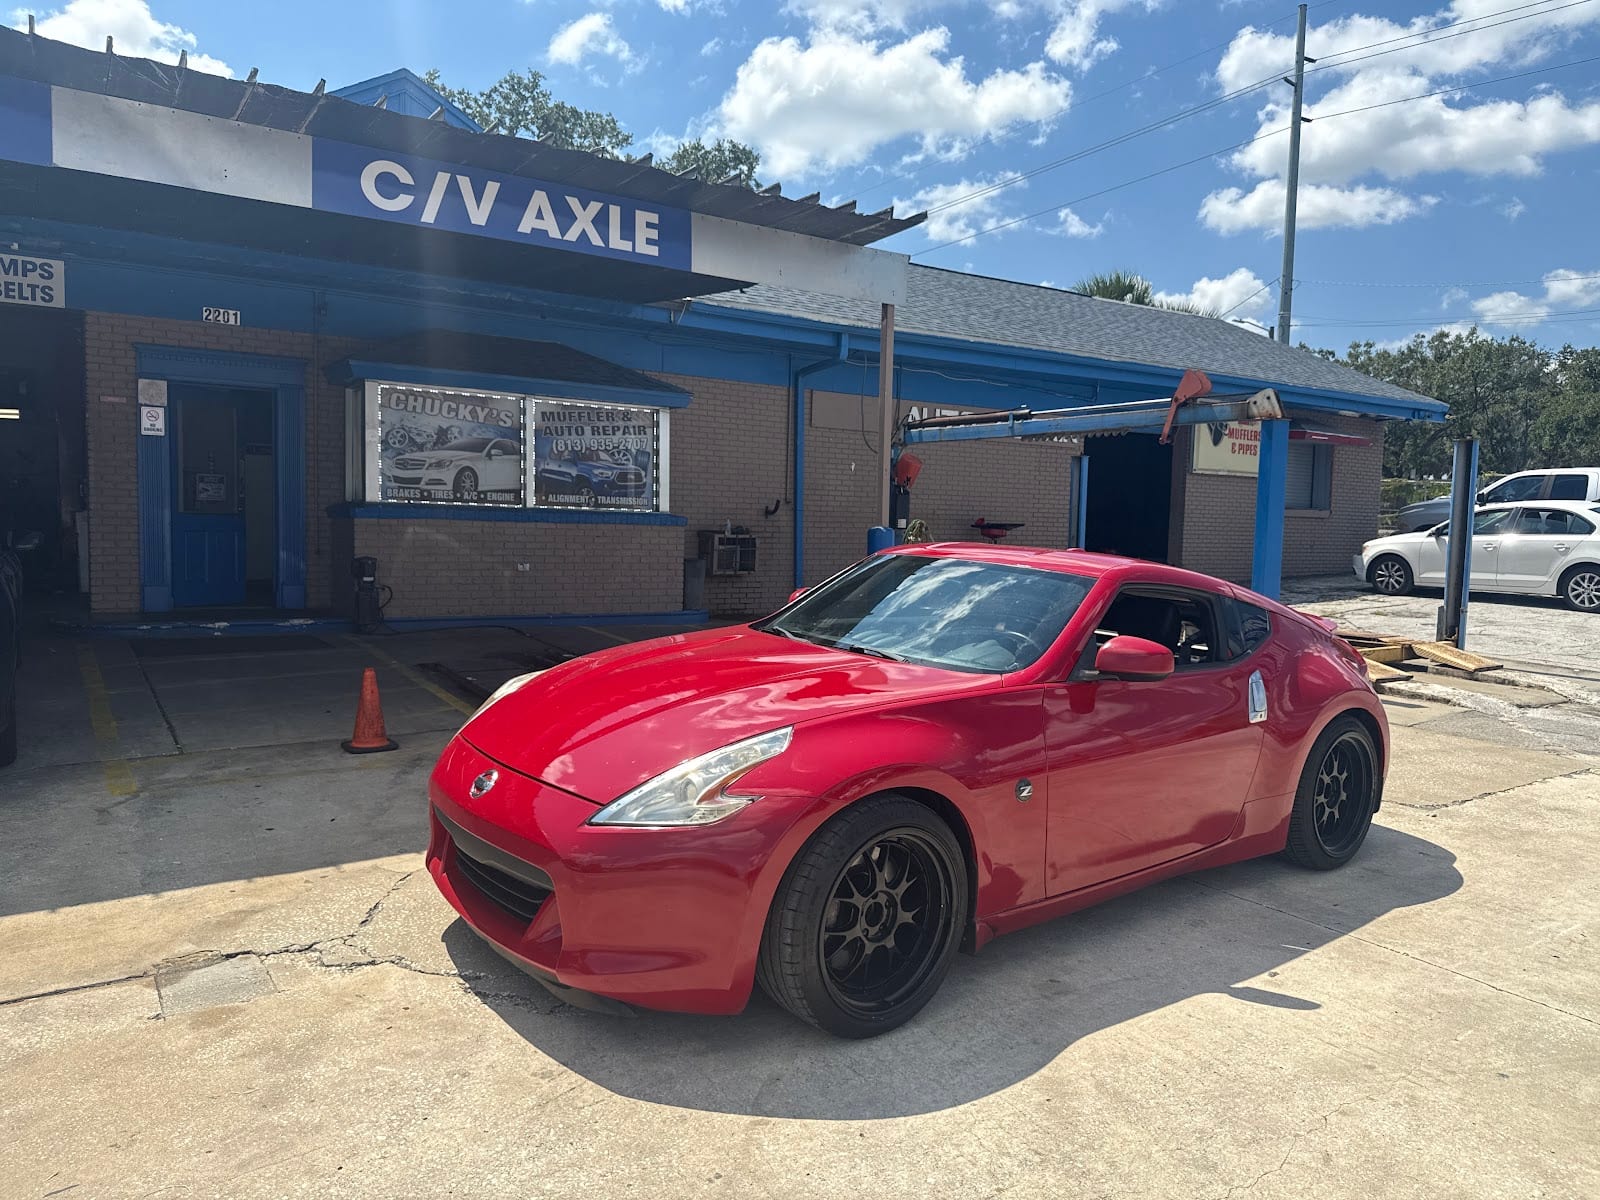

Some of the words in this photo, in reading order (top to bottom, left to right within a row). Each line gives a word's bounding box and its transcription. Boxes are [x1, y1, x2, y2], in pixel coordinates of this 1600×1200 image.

[360, 159, 501, 226] C/V
[517, 189, 659, 257] AXLE
[0, 281, 54, 304] ELTS
[204, 308, 238, 325] 2201
[389, 392, 514, 427] CHUCKY'S
[540, 411, 615, 422] MUFFLER
[621, 411, 633, 422] &
[543, 425, 585, 437] AUTO
[590, 425, 647, 436] REPAIR
[552, 438, 586, 454] (813)
[590, 437, 649, 451] 935-2707
[1238, 443, 1258, 456] PIPES
[386, 488, 420, 498] BRAKES
[430, 490, 454, 499] TIRES
[463, 491, 478, 500] A/C
[487, 492, 515, 501] ENGINE
[547, 493, 590, 503] ALIGNMENT
[597, 495, 649, 505] TRANSMISSION
